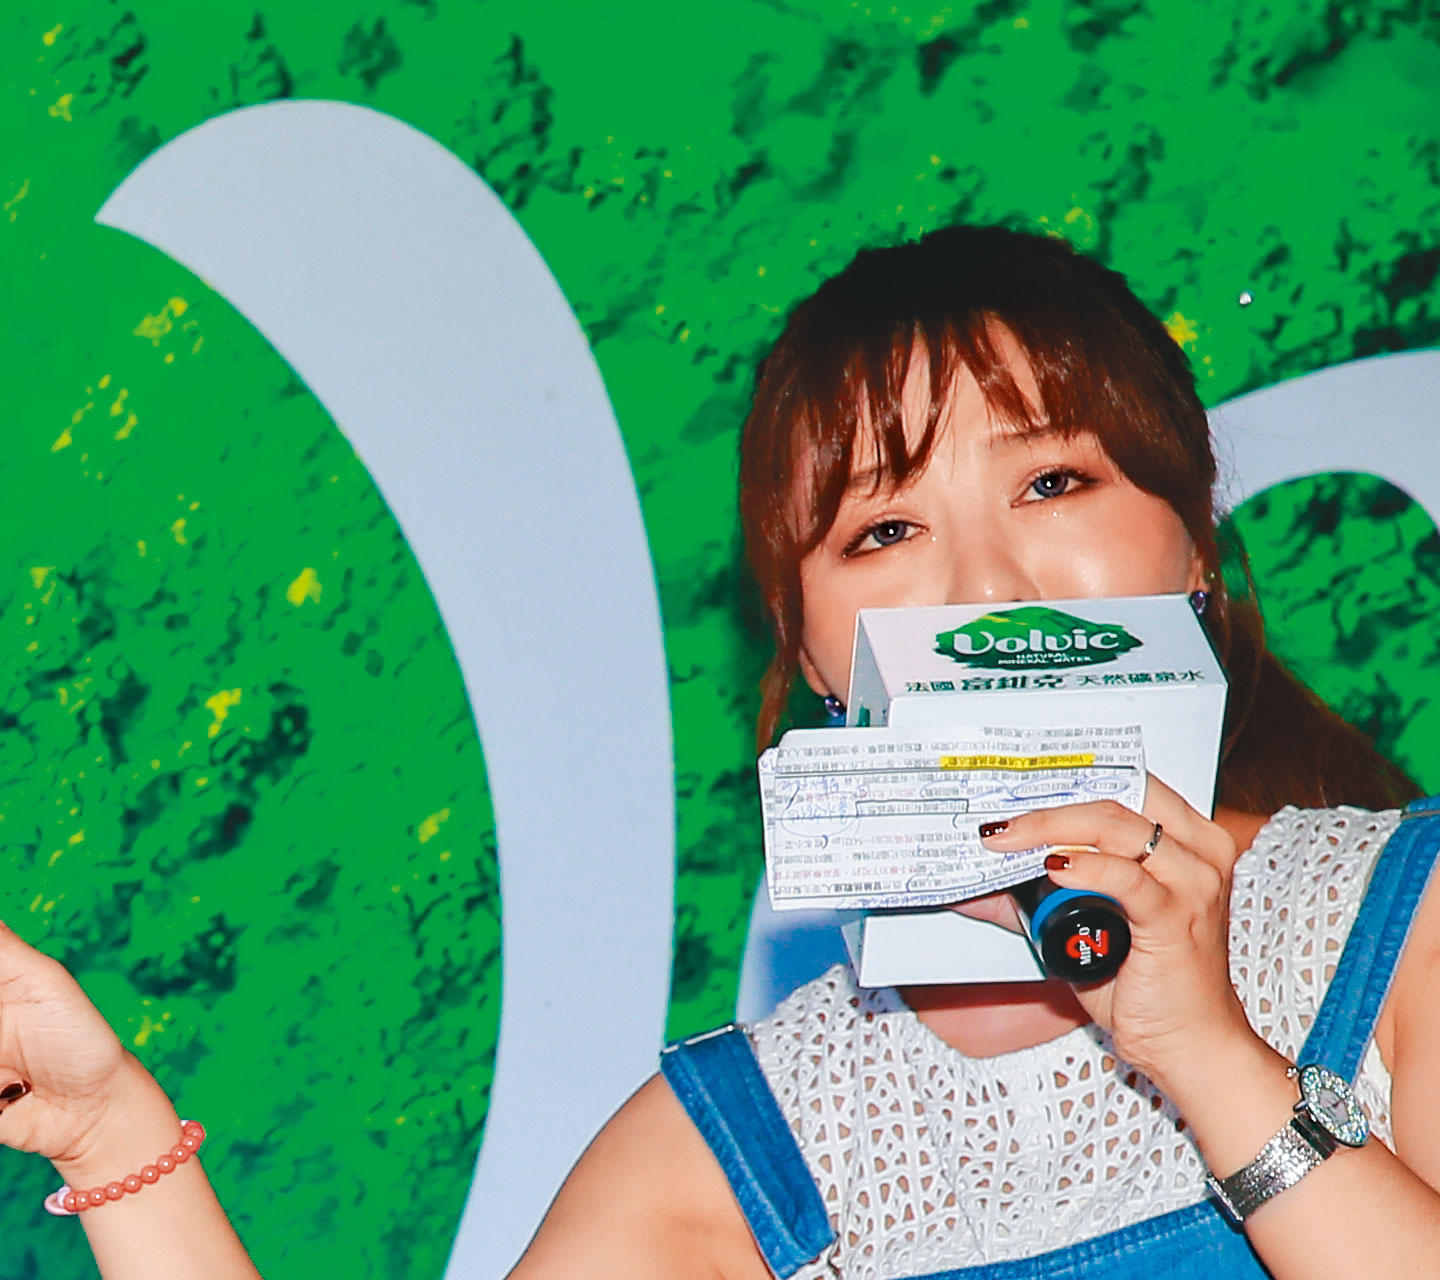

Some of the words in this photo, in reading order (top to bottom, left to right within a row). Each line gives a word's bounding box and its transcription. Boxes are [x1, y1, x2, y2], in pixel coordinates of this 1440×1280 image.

[953, 629, 1120, 655] Volvic
[1053, 655, 1092, 663] WATER
[905, 680, 956, 693] 法國
[960, 674, 1065, 691] 富維克
[1076, 669, 1206, 686] 天然礦泉水
[1066, 930, 1109, 959] 2
